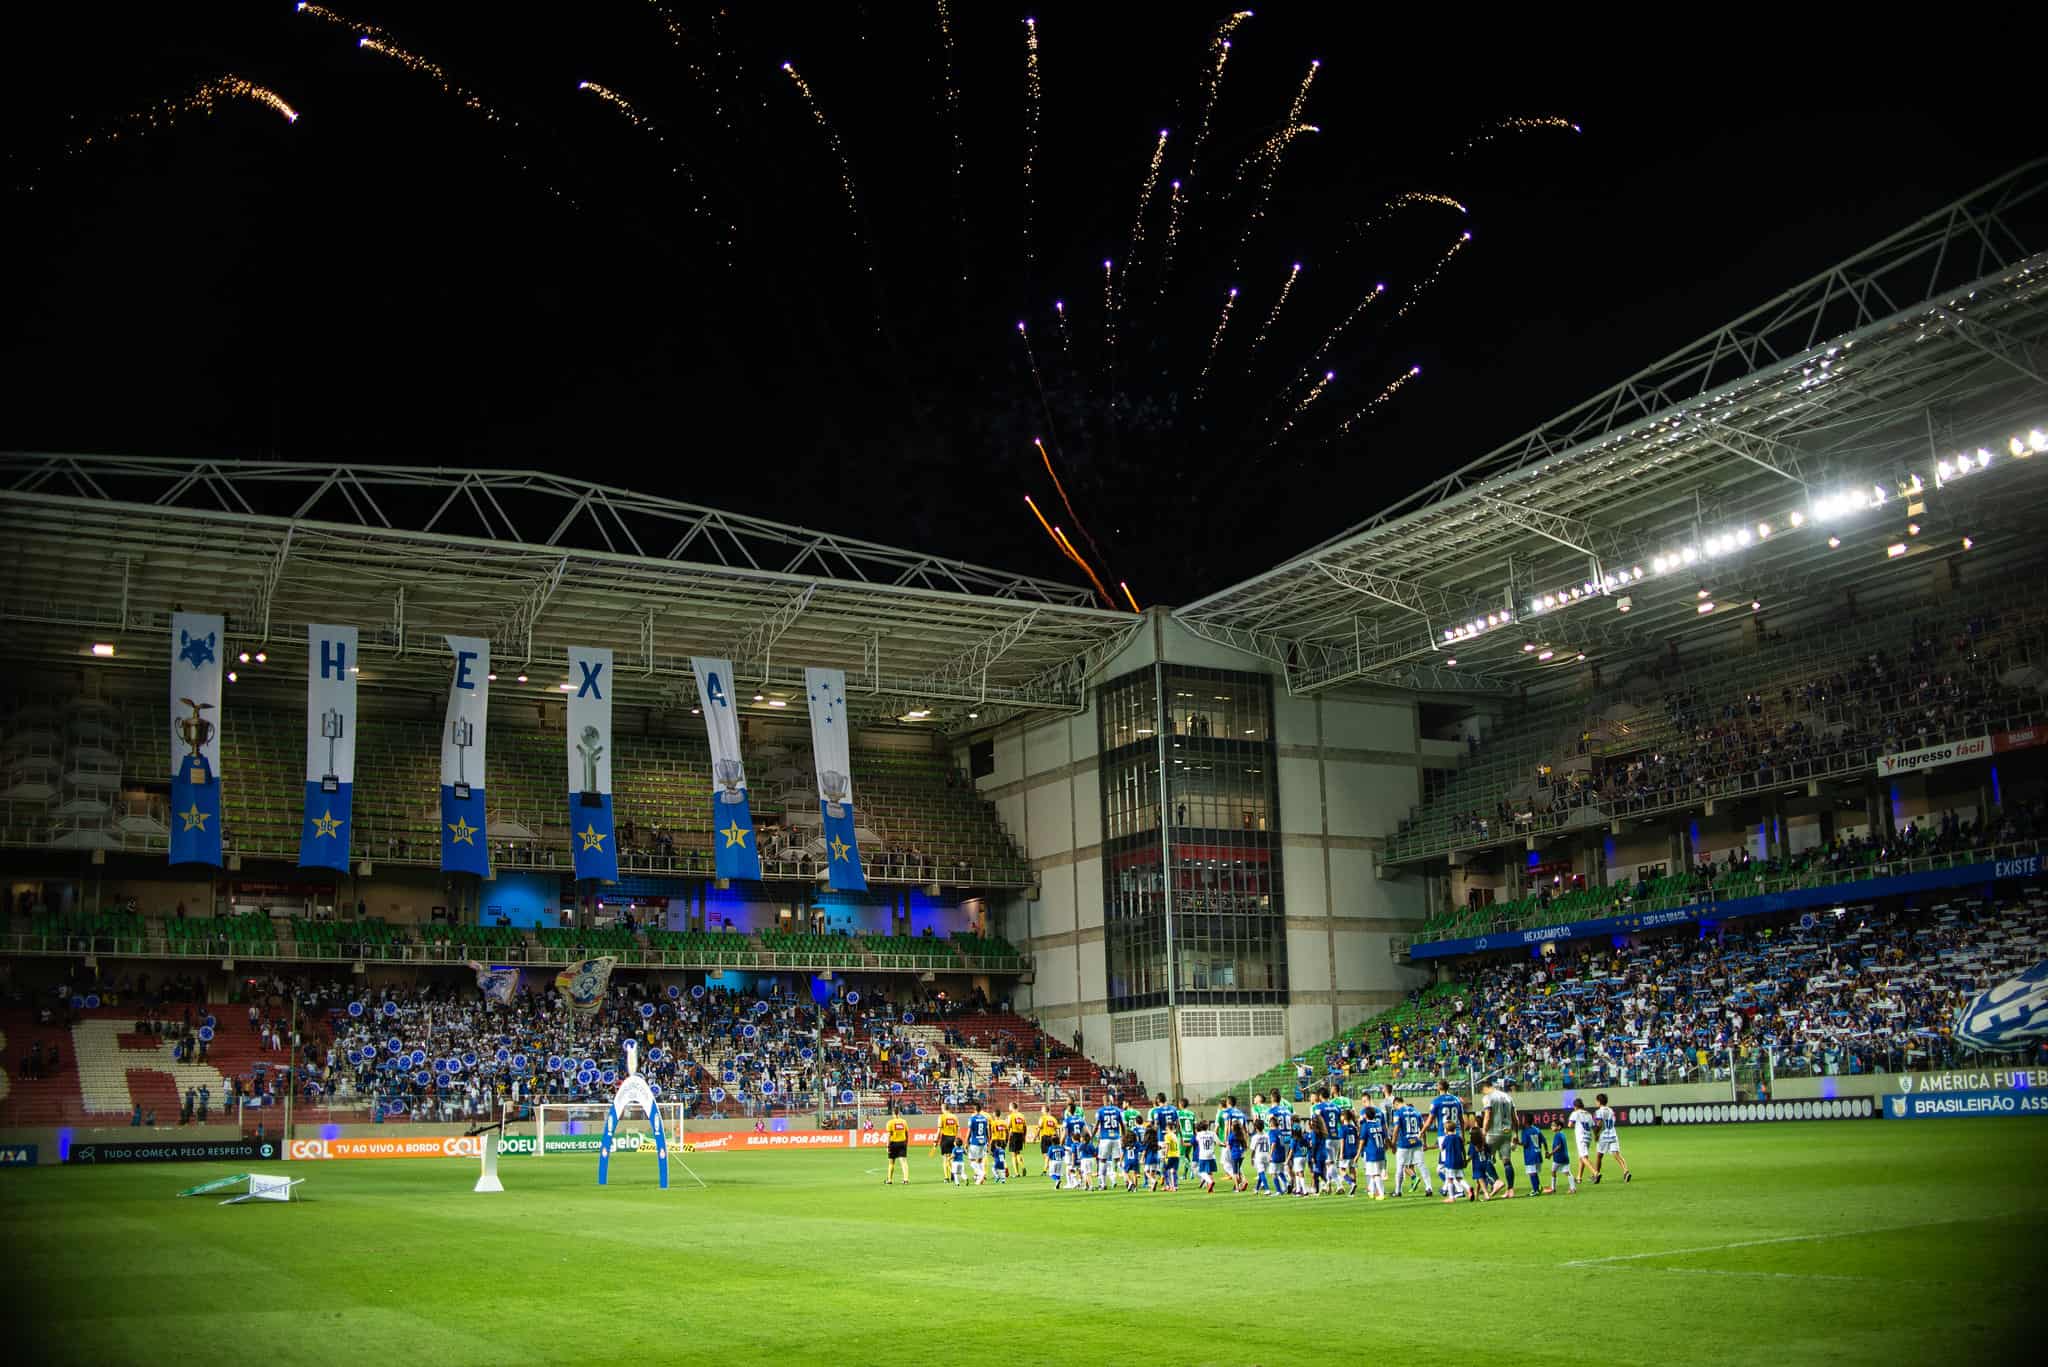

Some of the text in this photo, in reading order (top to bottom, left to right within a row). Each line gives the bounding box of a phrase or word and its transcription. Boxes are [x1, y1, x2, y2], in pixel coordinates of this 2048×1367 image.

[321, 640, 346, 681] H
[456, 651, 478, 689] E
[577, 661, 603, 699] X
[707, 672, 727, 707] A
[1897, 740, 1985, 768] ingresso fácil
[1995, 857, 2037, 878] EXISTE
[1524, 926, 1571, 942] HEXACAMPEÃO
[1919, 1072, 1990, 1092] AMÉRICA
[1915, 1095, 2015, 1113] BRASILEIRÃO
[1104, 1115, 1118, 1129] 26
[1328, 1112, 1336, 1130] 3
[1405, 1117, 1417, 1133] 19
[292, 1140, 334, 1159] GOL
[336, 1144, 350, 1153] TV
[352, 1144, 367, 1153] AO
[370, 1144, 394, 1153] VIVO
[396, 1144, 404, 1153] A
[406, 1143, 440, 1153] BORDO
[747, 1135, 844, 1145] SEJA PRO POR APENAS
[104, 1149, 132, 1158] TUDO
[181, 1147, 205, 1156] PELO
[208, 1146, 252, 1156] RESPEITO
